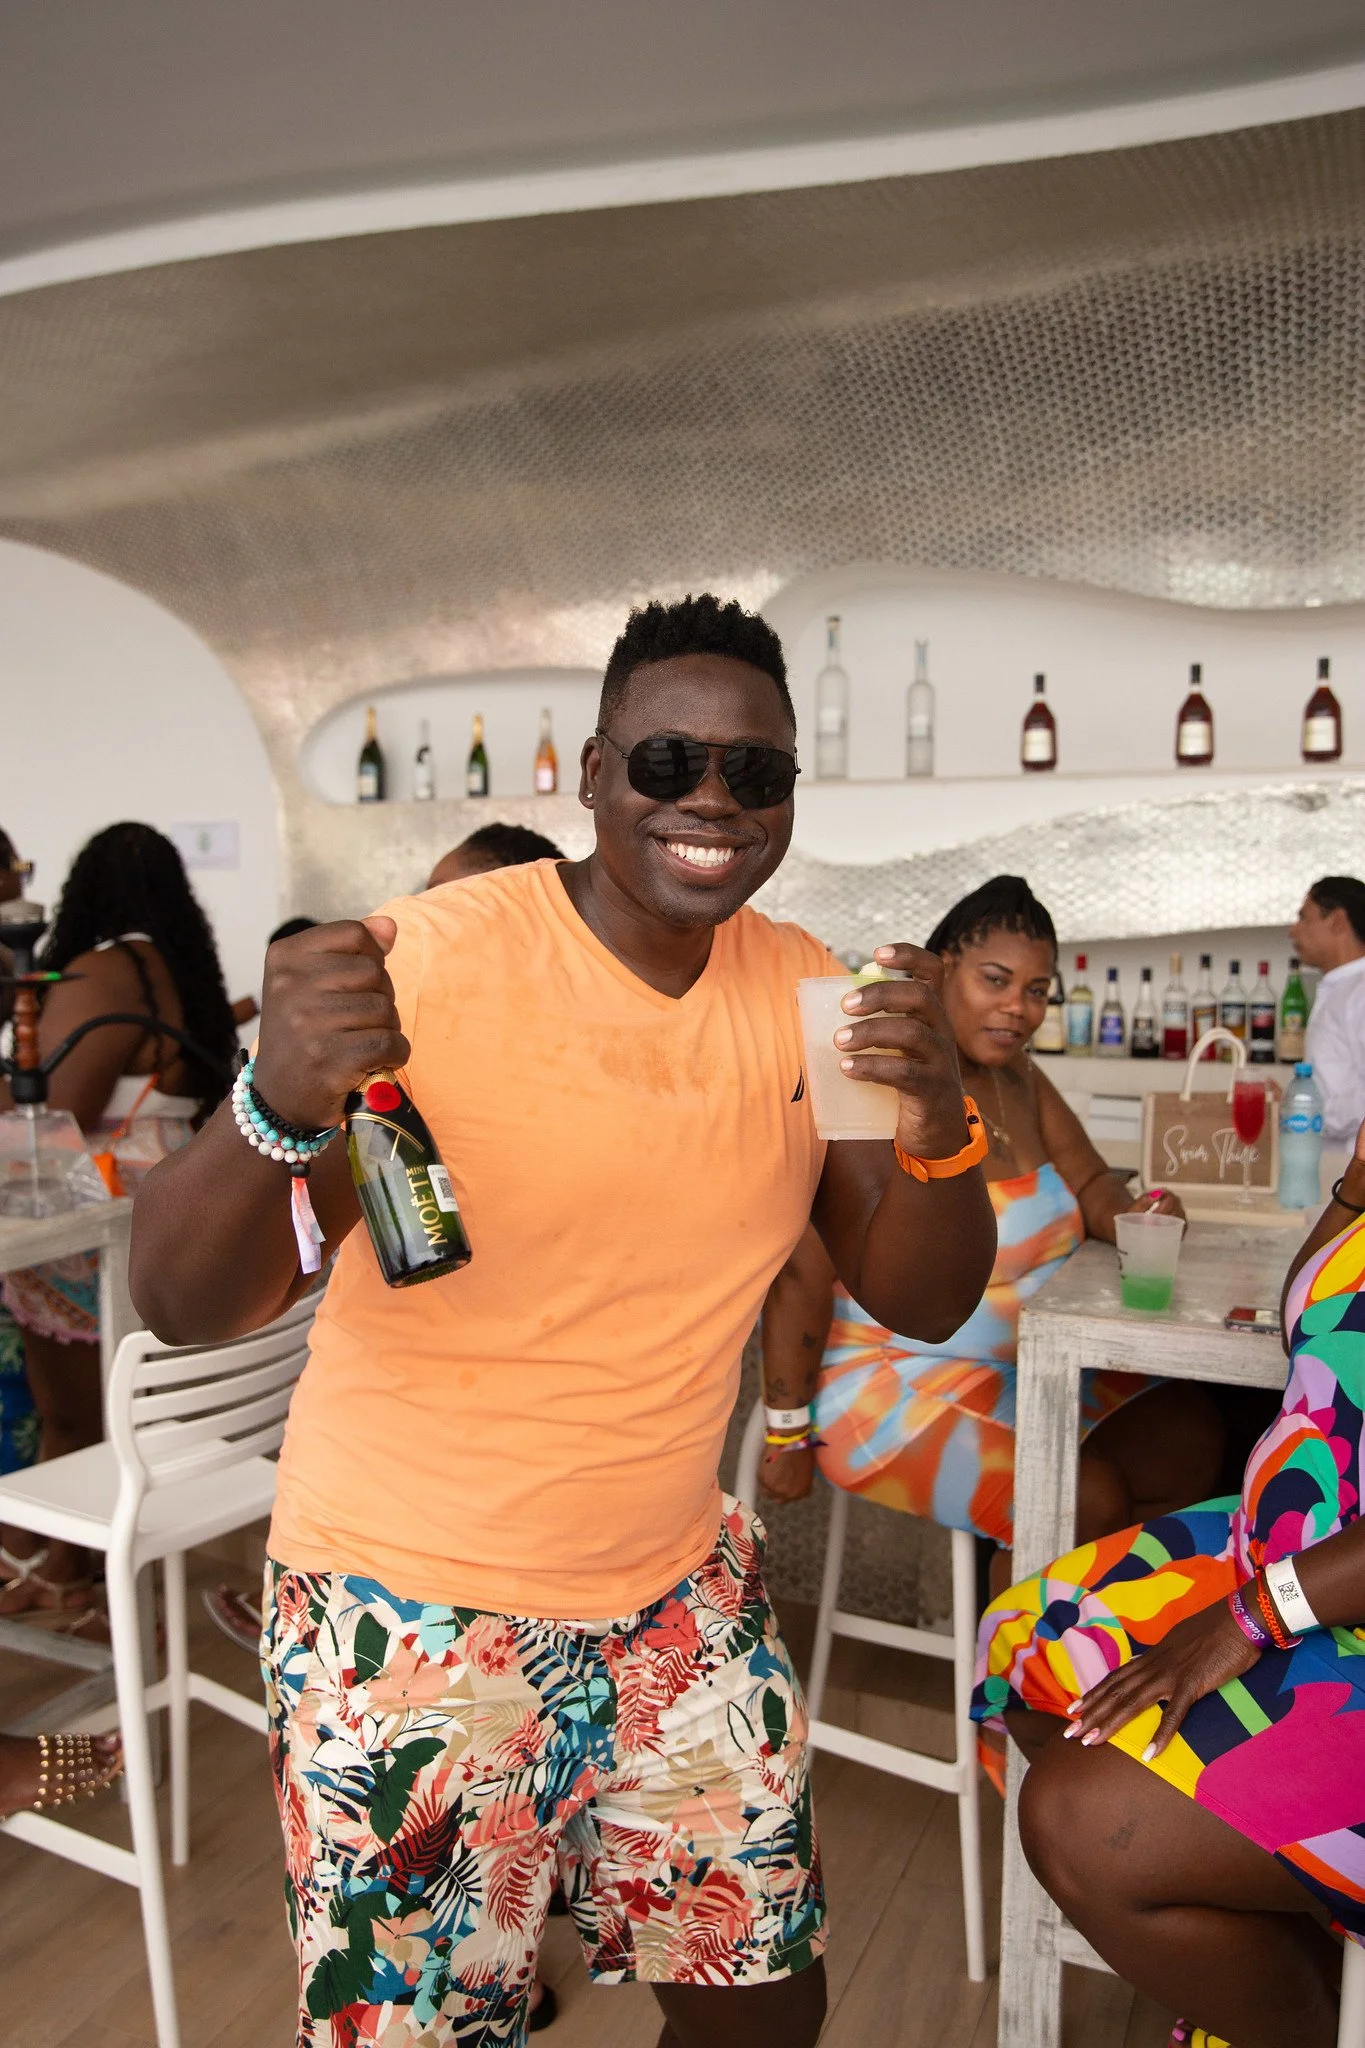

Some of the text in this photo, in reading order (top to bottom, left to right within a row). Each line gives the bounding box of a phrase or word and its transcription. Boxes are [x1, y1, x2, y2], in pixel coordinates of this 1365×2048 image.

[406, 1165, 425, 1177] MINI
[408, 1178, 447, 1246] MOËT
[1243, 1615, 1264, 1639] Swim
